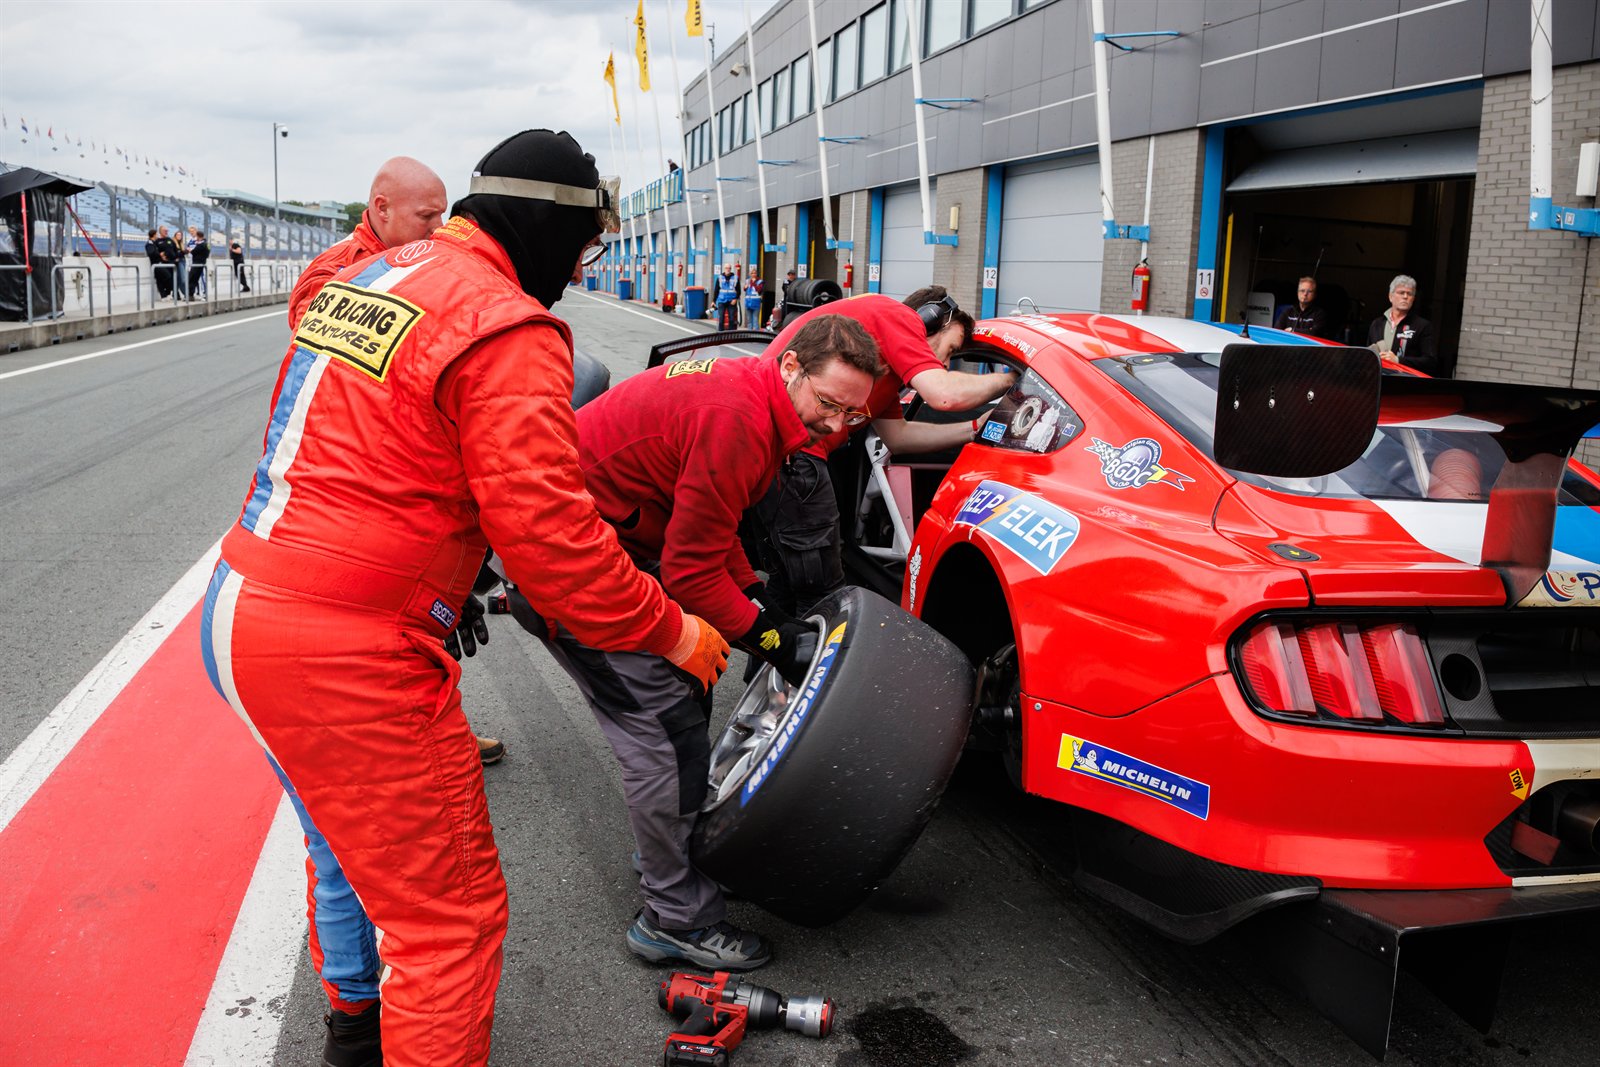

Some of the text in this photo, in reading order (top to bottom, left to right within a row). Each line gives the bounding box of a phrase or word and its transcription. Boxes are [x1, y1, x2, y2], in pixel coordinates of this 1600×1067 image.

[871, 266, 879, 275] 13
[986, 269, 996, 279] 12
[1199, 272, 1212, 285] 11
[329, 296, 397, 336] RACING
[1017, 340, 1031, 354] VDS
[1103, 458, 1153, 487] BGDC
[962, 488, 1005, 515] HELP
[999, 503, 1074, 560] ELEK
[433, 601, 455, 625] sparco
[747, 666, 827, 794] MICHELIN
[1102, 760, 1192, 801] MICHELIN
[1510, 769, 1524, 790] TOW
